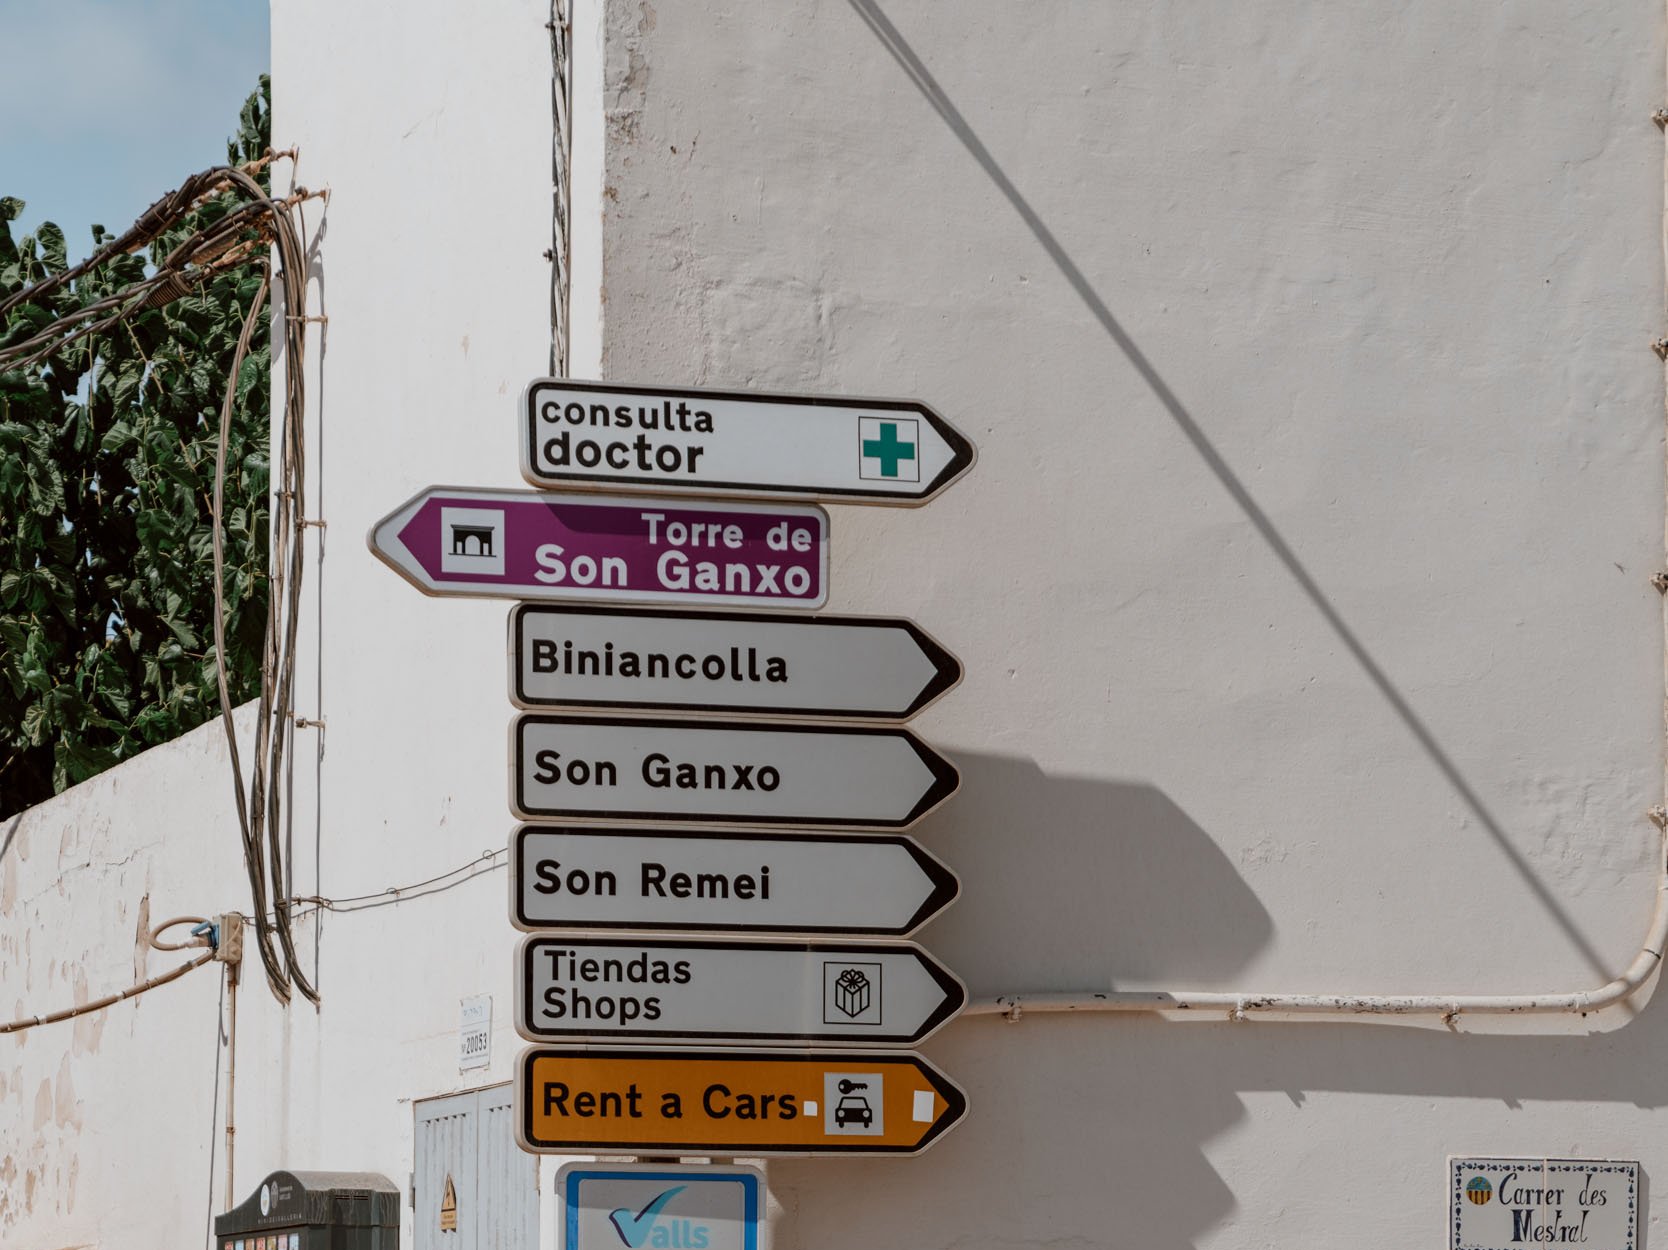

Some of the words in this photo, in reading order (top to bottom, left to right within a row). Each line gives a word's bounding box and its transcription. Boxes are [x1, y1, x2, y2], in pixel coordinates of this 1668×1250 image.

[541, 401, 714, 433] consulta
[543, 431, 704, 474] doctor
[642, 513, 744, 549] Torre
[767, 521, 812, 552] de
[534, 544, 628, 587] Son
[657, 551, 811, 596] Ganxo
[532, 638, 789, 683] Biniancolla
[533, 749, 617, 786] Son
[641, 752, 781, 792] Ganxo
[533, 859, 617, 896] Son
[641, 862, 770, 900] Remei
[544, 949, 692, 985] Tiendas
[542, 986, 662, 1026] Shops
[467, 1032, 487, 1054] 20053
[543, 1081, 643, 1119] Rent
[660, 1092, 683, 1119] a
[702, 1083, 798, 1120] Cars
[1499, 1172, 1565, 1206] Carrer
[1578, 1173, 1608, 1207] des
[608, 1184, 710, 1249] Valls
[1511, 1208, 1590, 1243] Mestral
